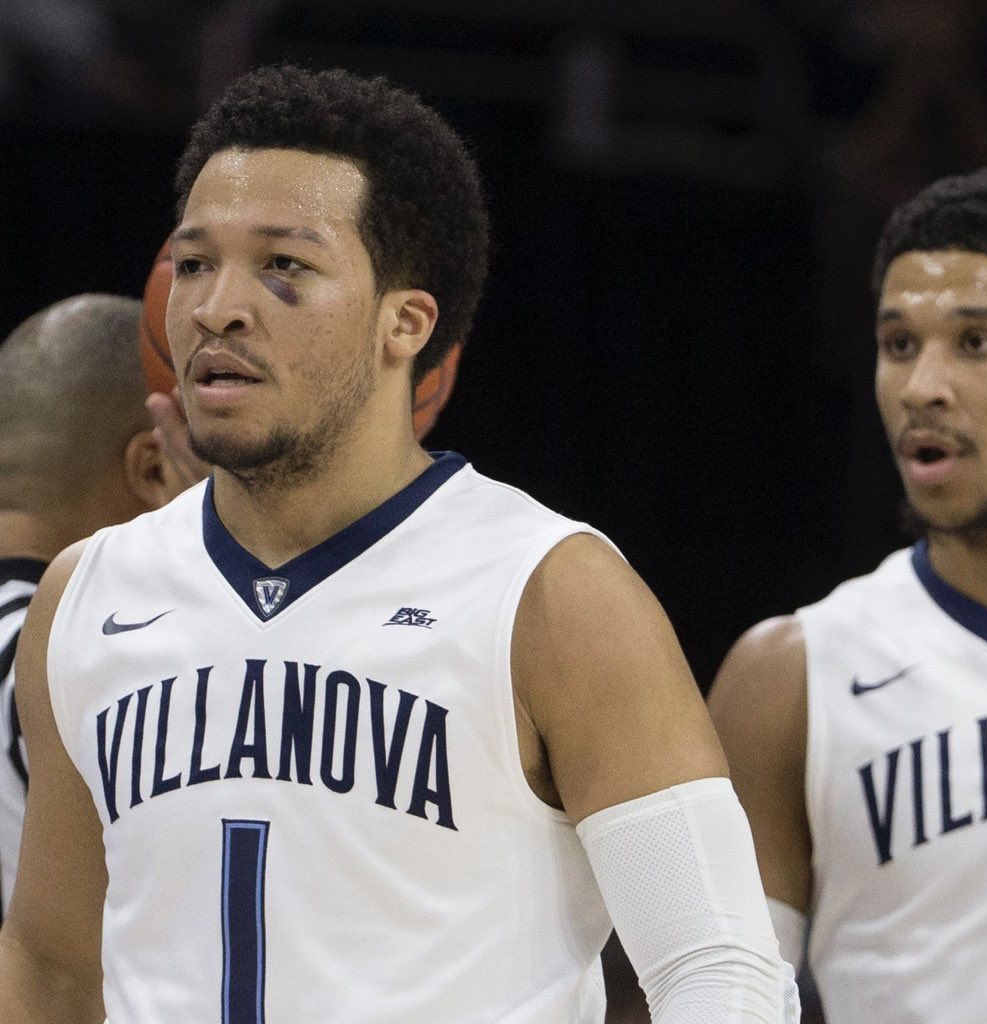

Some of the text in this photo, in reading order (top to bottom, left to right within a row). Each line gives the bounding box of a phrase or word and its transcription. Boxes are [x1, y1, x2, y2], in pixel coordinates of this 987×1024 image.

[396, 606, 431, 618] BIG
[388, 613, 438, 625] EAST
[95, 658, 459, 832] VILLANOVA
